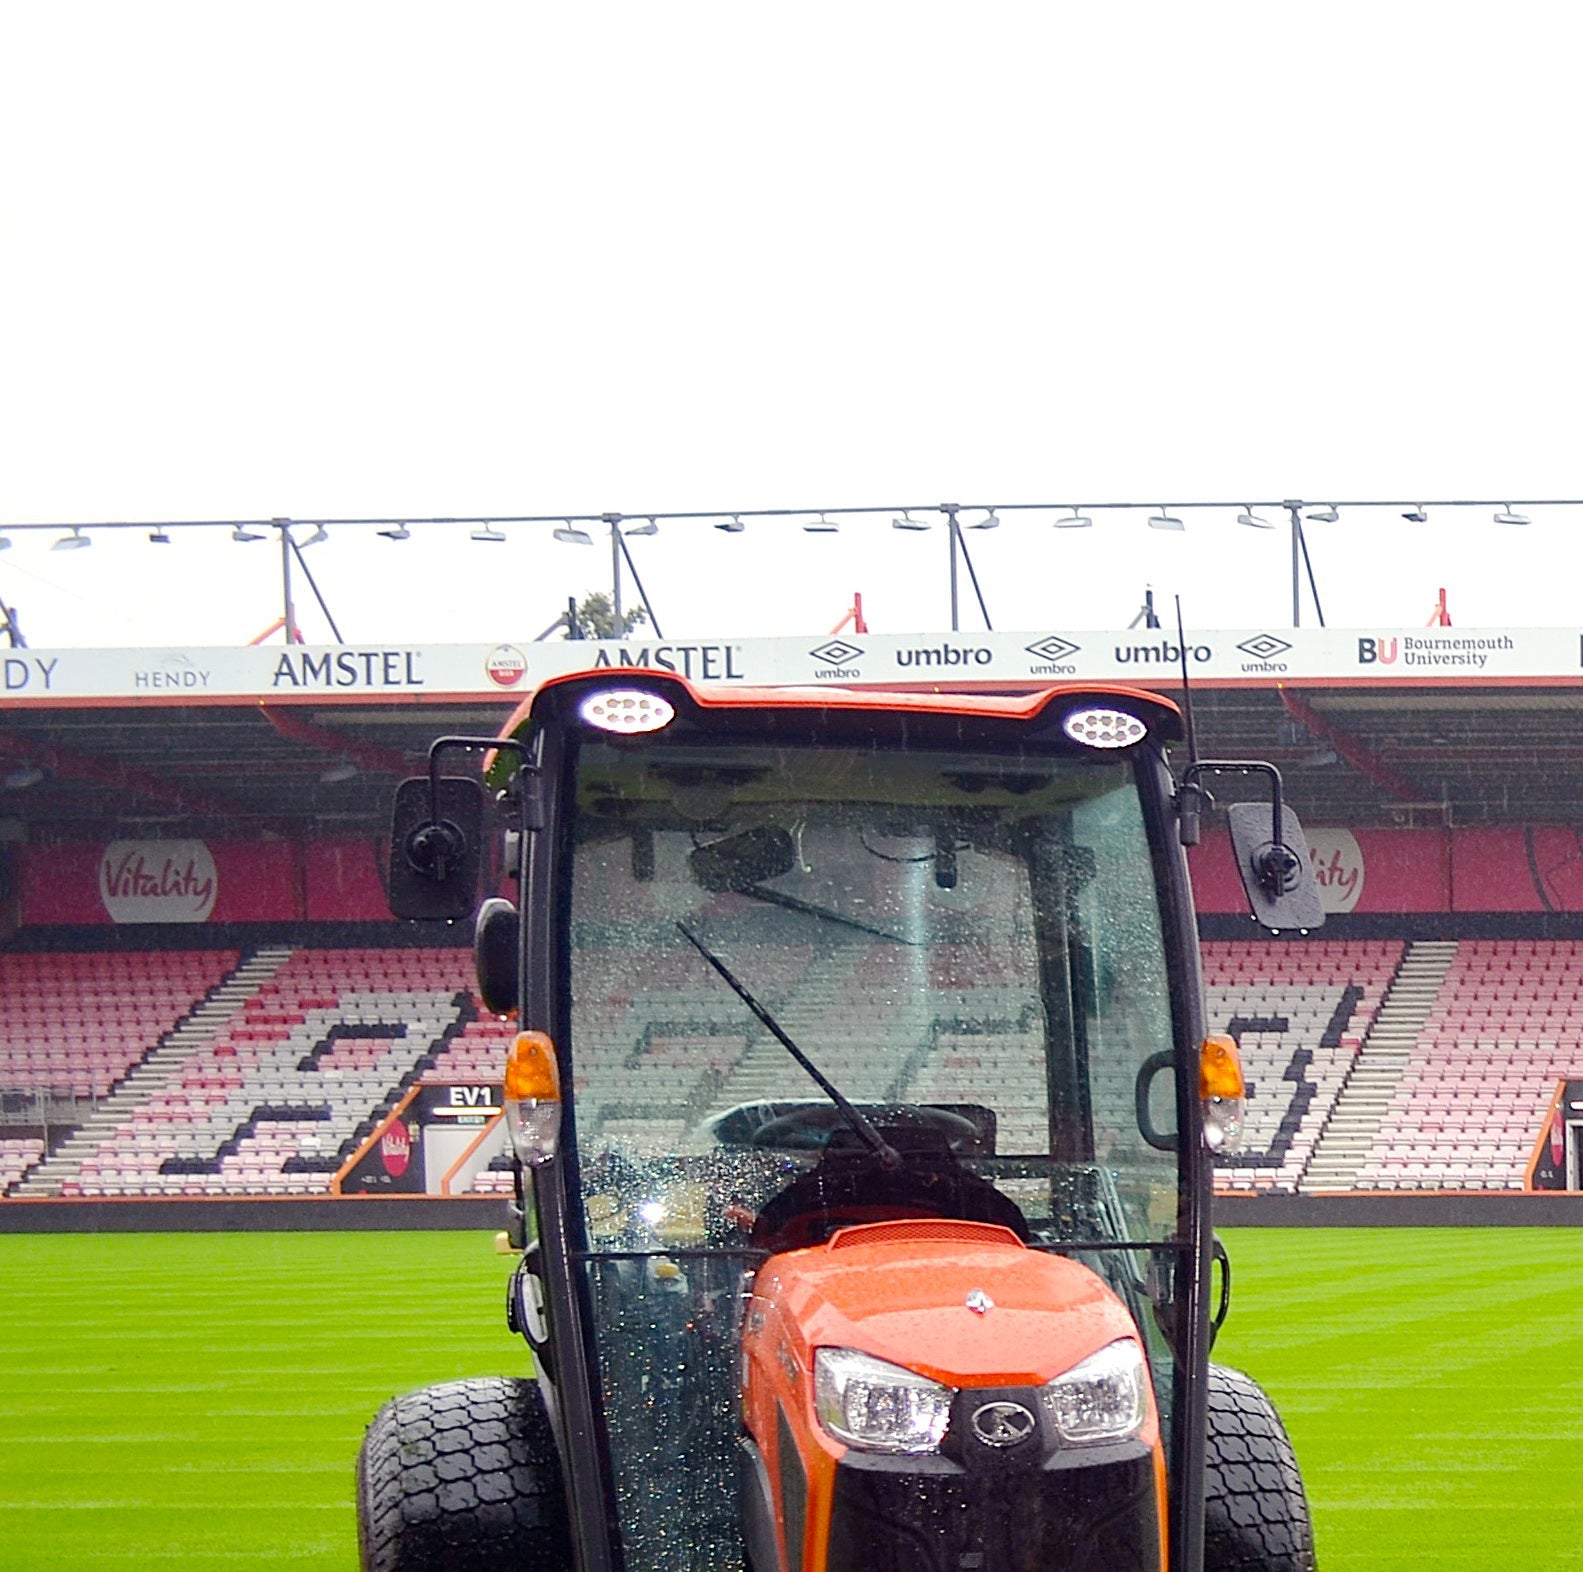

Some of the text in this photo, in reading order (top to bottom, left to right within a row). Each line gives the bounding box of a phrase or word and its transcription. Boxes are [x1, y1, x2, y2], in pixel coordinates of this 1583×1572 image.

[1114, 640, 1212, 664] umbro
[1358, 636, 1398, 665] BU
[1403, 635, 1514, 651] Bournemouth
[896, 642, 993, 667] umbro
[1403, 650, 1489, 668] University
[273, 651, 424, 687] AMSTEL
[814, 665, 861, 680] umbro
[1029, 661, 1077, 675] umbro
[1240, 660, 1288, 673] umbro
[135, 671, 211, 688] HENDY
[105, 851, 213, 912] Vitality
[449, 1086, 493, 1106] EV1
